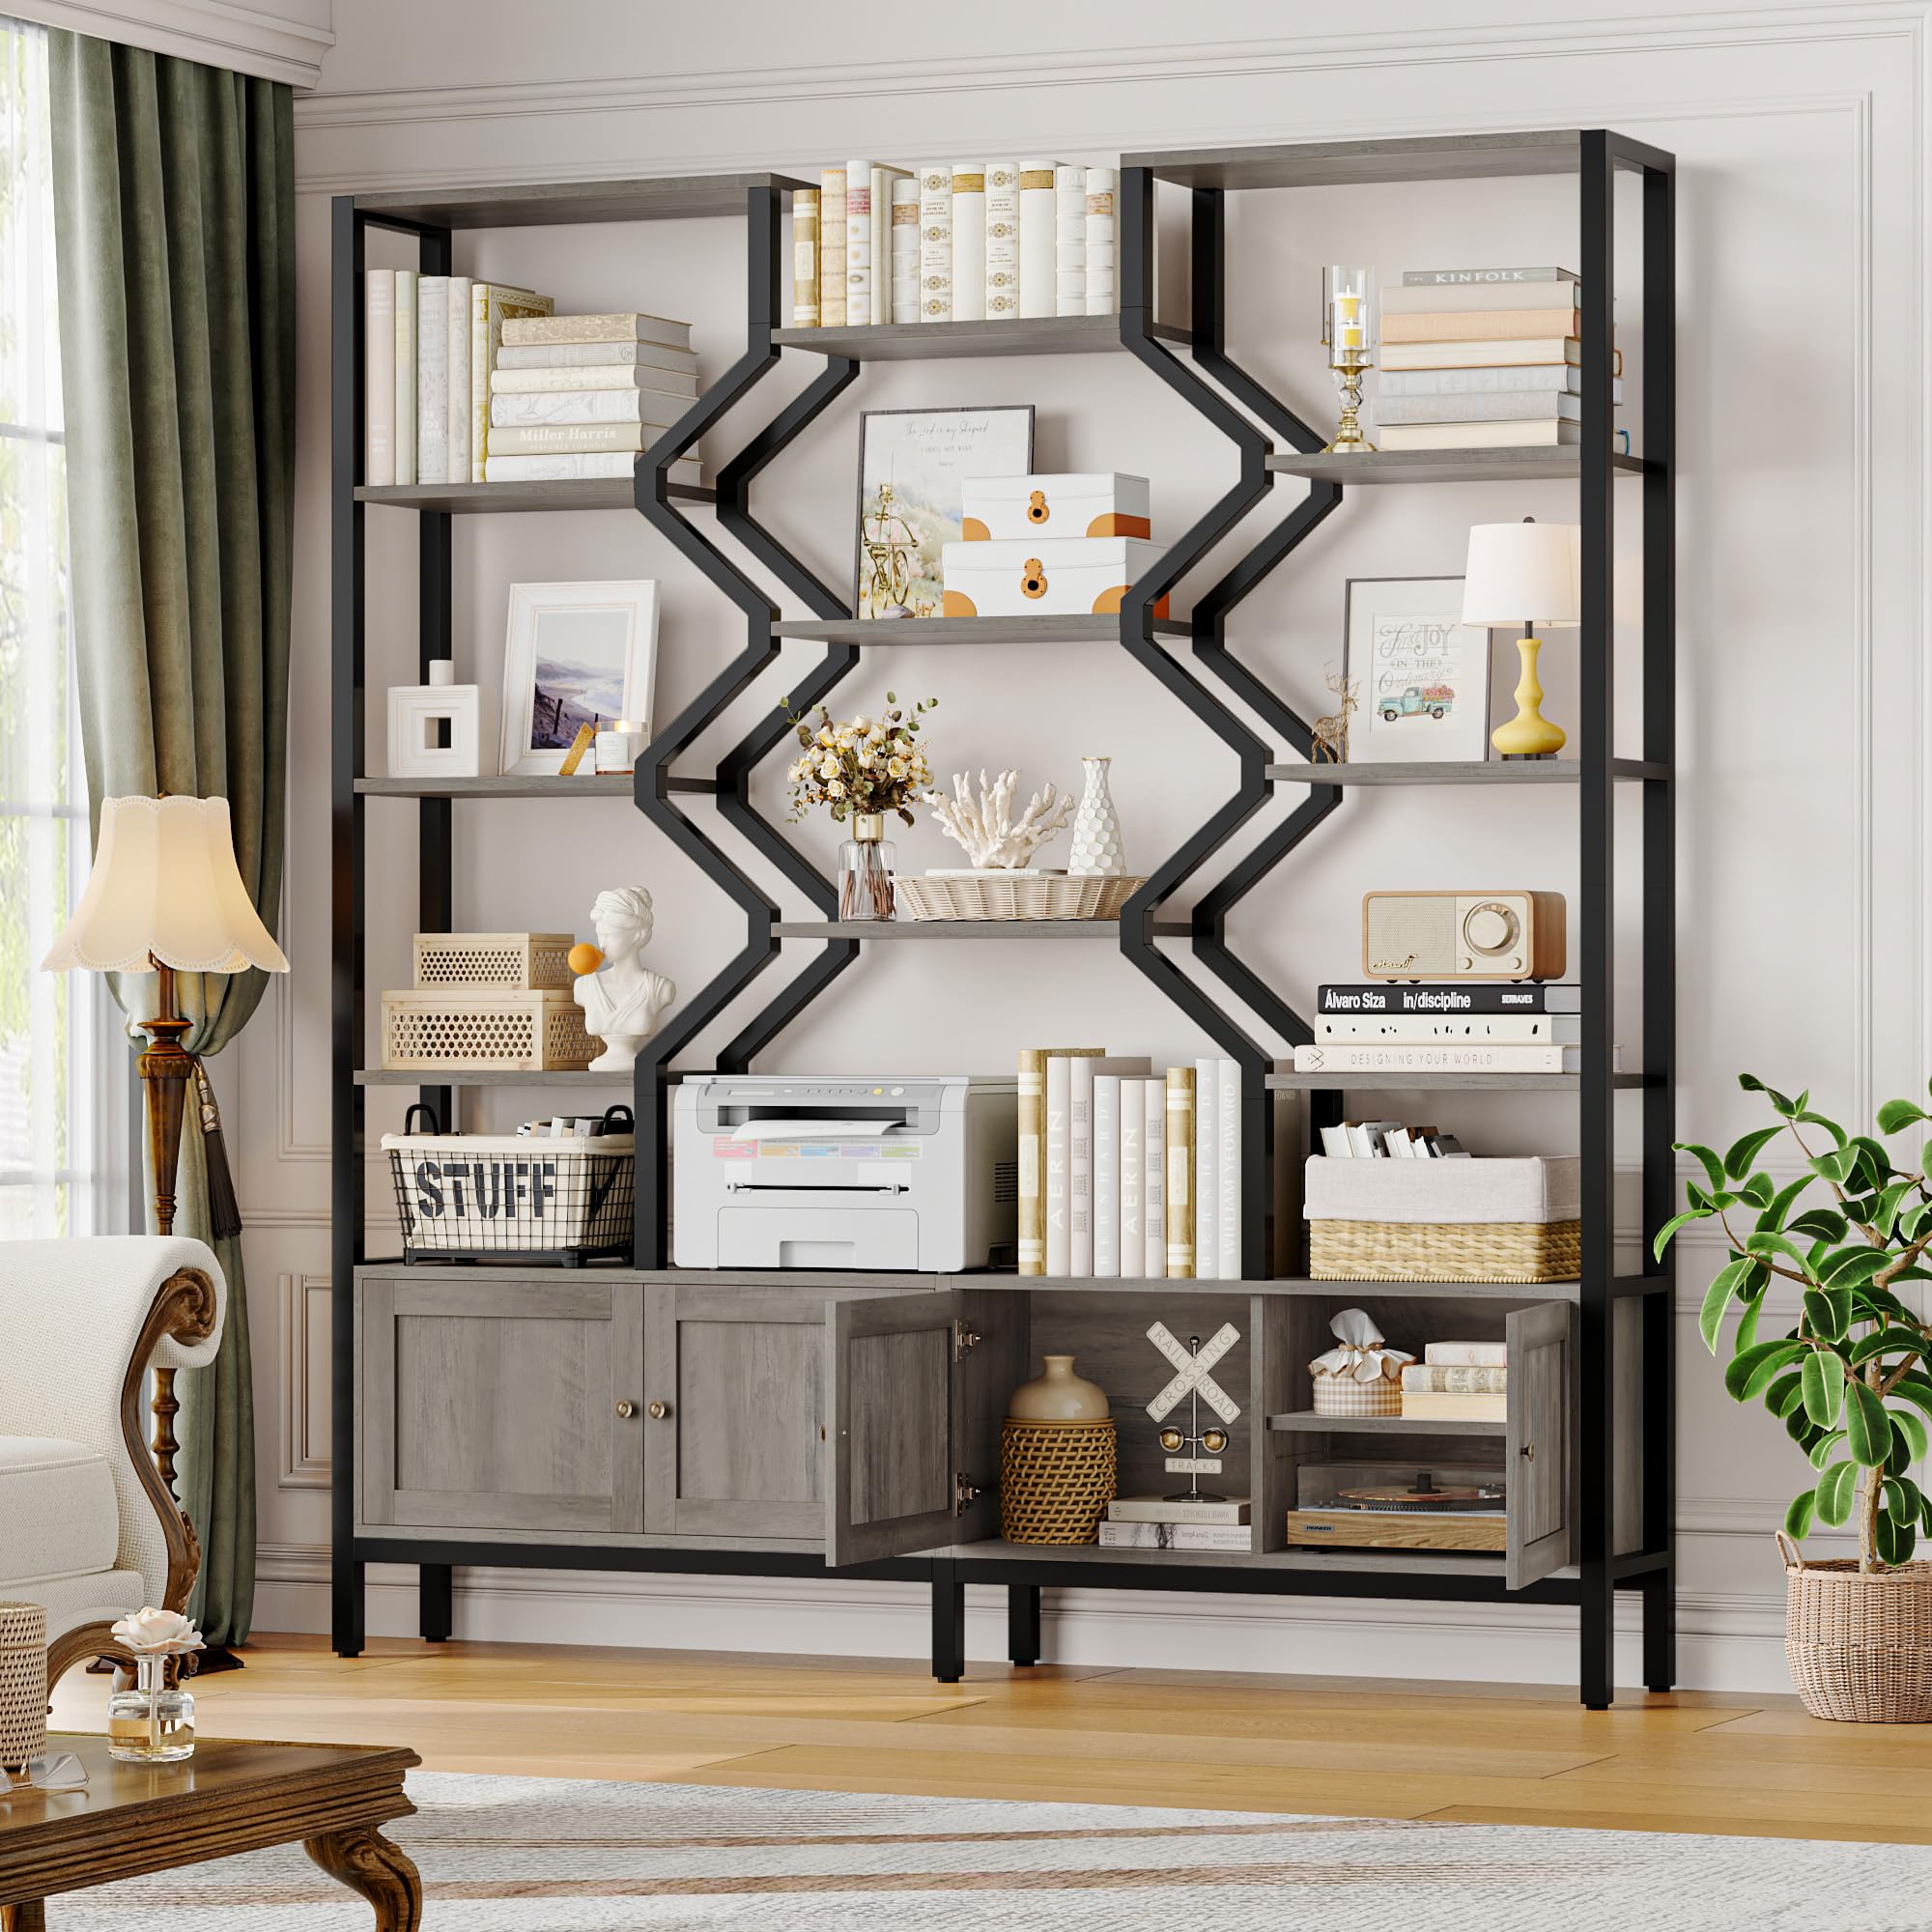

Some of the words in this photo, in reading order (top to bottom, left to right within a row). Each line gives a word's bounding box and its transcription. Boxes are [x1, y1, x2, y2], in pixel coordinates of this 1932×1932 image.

[1435, 270, 1525, 283] KINFOLK
[519, 429, 565, 442] Miller
[569, 426, 617, 440] Harris
[1414, 624, 1456, 656] JOY
[1414, 659, 1437, 668] THE
[1324, 989, 1360, 1009] Álvaro
[1362, 992, 1386, 1009] Siza
[1403, 992, 1471, 1011] in/discipline
[1350, 1053, 1413, 1065] DESIGNING
[1419, 1053, 1448, 1065] YOUR
[1454, 1054, 1492, 1065] WORLD
[1221, 1083, 1236, 1173] YEOWARD
[416, 1161, 555, 1219] STUFF
[1049, 1110, 1065, 1230] AERIN
[1123, 1127, 1138, 1235] AERIN
[1221, 1179, 1236, 1254] WILLIAM
[1153, 1328, 1186, 1366] RAIL
[1198, 1376, 1235, 1417] ROAD
[1154, 1331, 1232, 1413] CROSSING
[1171, 1461, 1217, 1471] TRACKS
